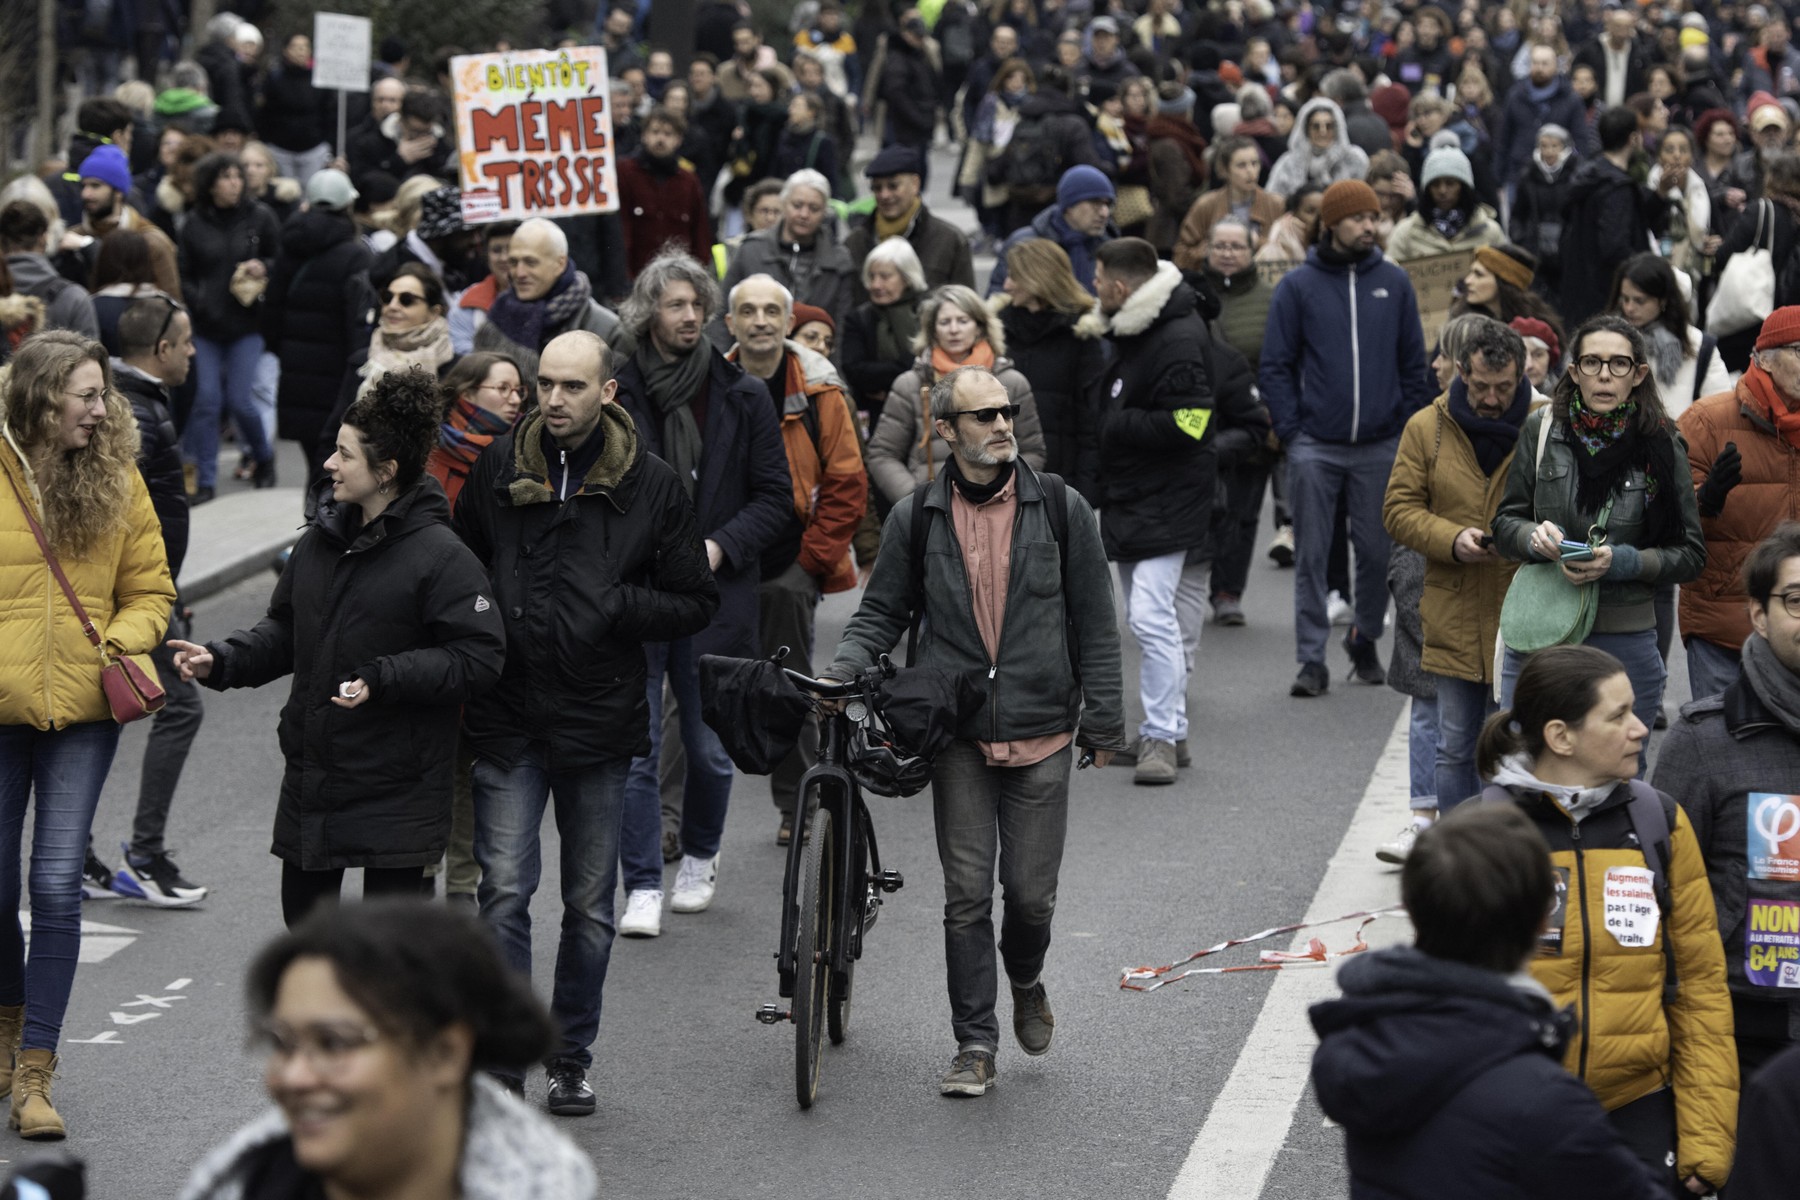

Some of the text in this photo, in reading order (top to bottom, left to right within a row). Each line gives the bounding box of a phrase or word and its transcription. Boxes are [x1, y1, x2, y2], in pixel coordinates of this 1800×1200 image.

[472, 85, 606, 152] MÉMÉ
[472, 156, 608, 210] TRESSE
[1754, 856, 1799, 867] La France
[1606, 887, 1655, 900] les salaires
[1607, 903, 1626, 914] pas
[1608, 917, 1634, 928] de la
[1751, 904, 1800, 933] NON
[1619, 932, 1645, 944] traite
[1756, 934, 1763, 943] LA
[1764, 934, 1794, 944] RETRAITE
[1750, 944, 1799, 972] 64 ANS
